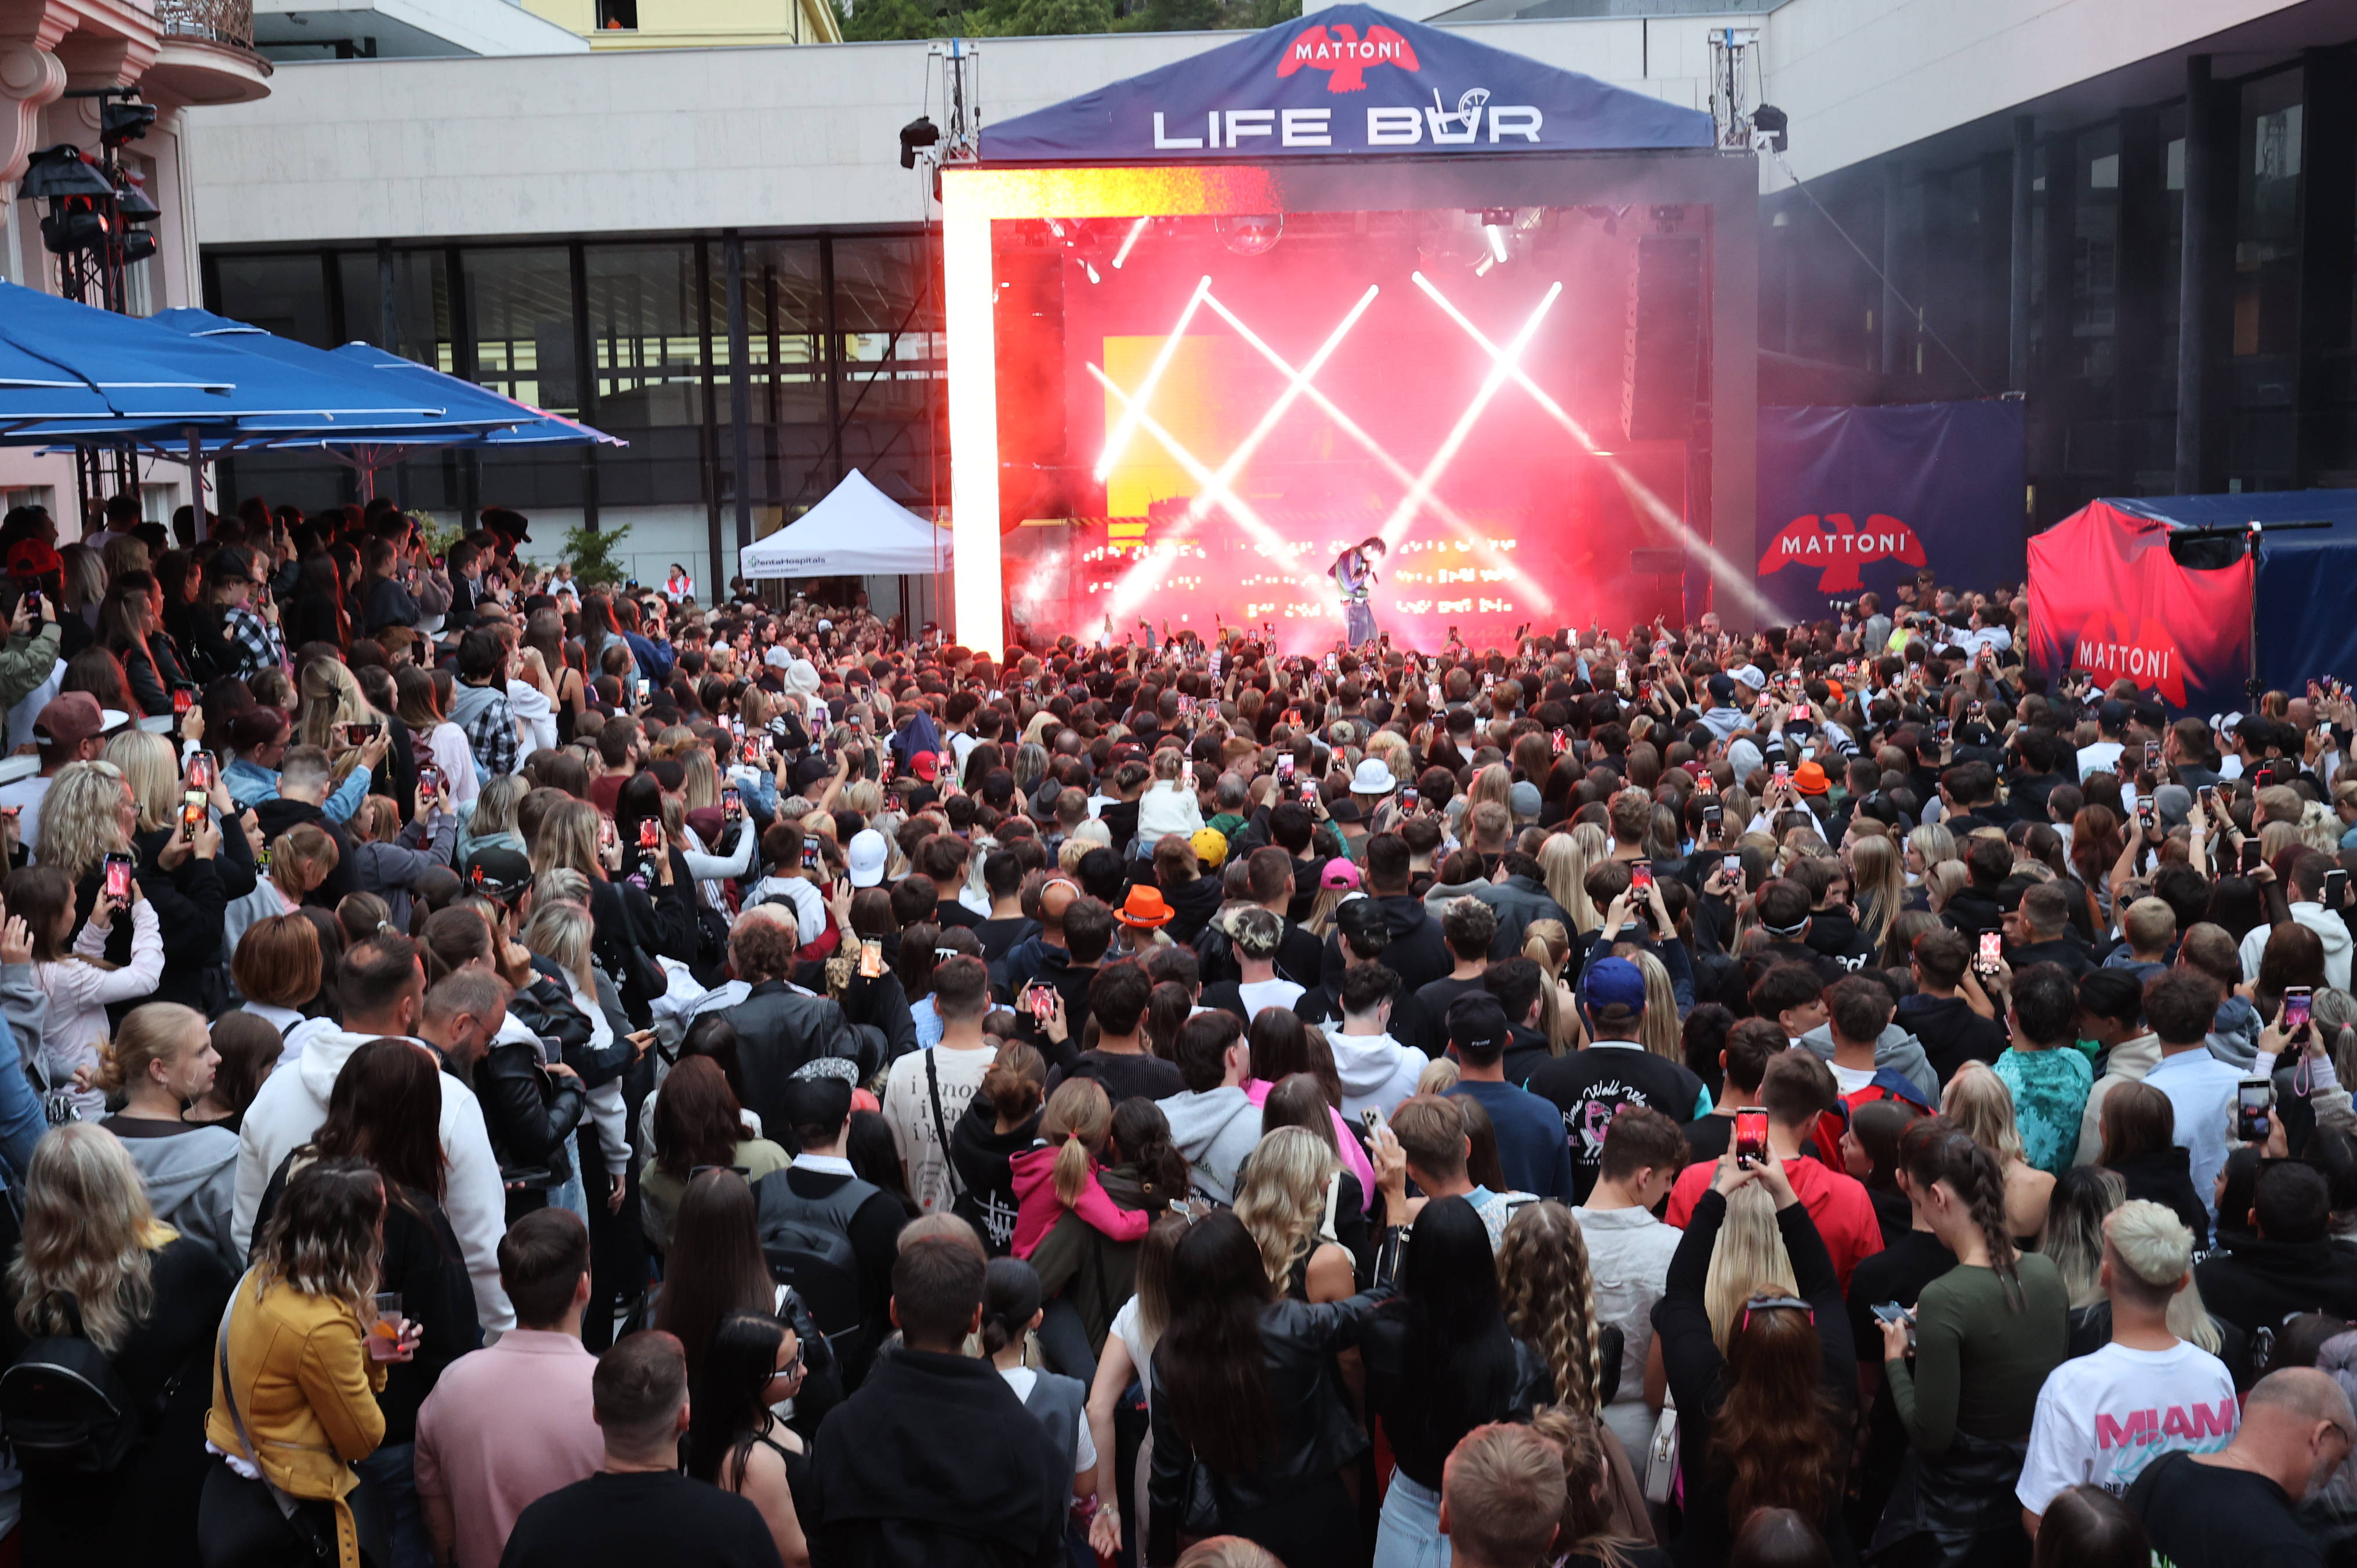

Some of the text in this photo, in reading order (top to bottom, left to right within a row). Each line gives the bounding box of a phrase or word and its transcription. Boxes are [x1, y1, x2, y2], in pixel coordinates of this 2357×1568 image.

[1296, 41, 1401, 60] MATTONI
[1154, 108, 1332, 149] LIFE
[1781, 533, 1905, 554] MATTONI
[2080, 640, 2169, 679] MATTONI
[1583, 1079, 1620, 1099] Well
